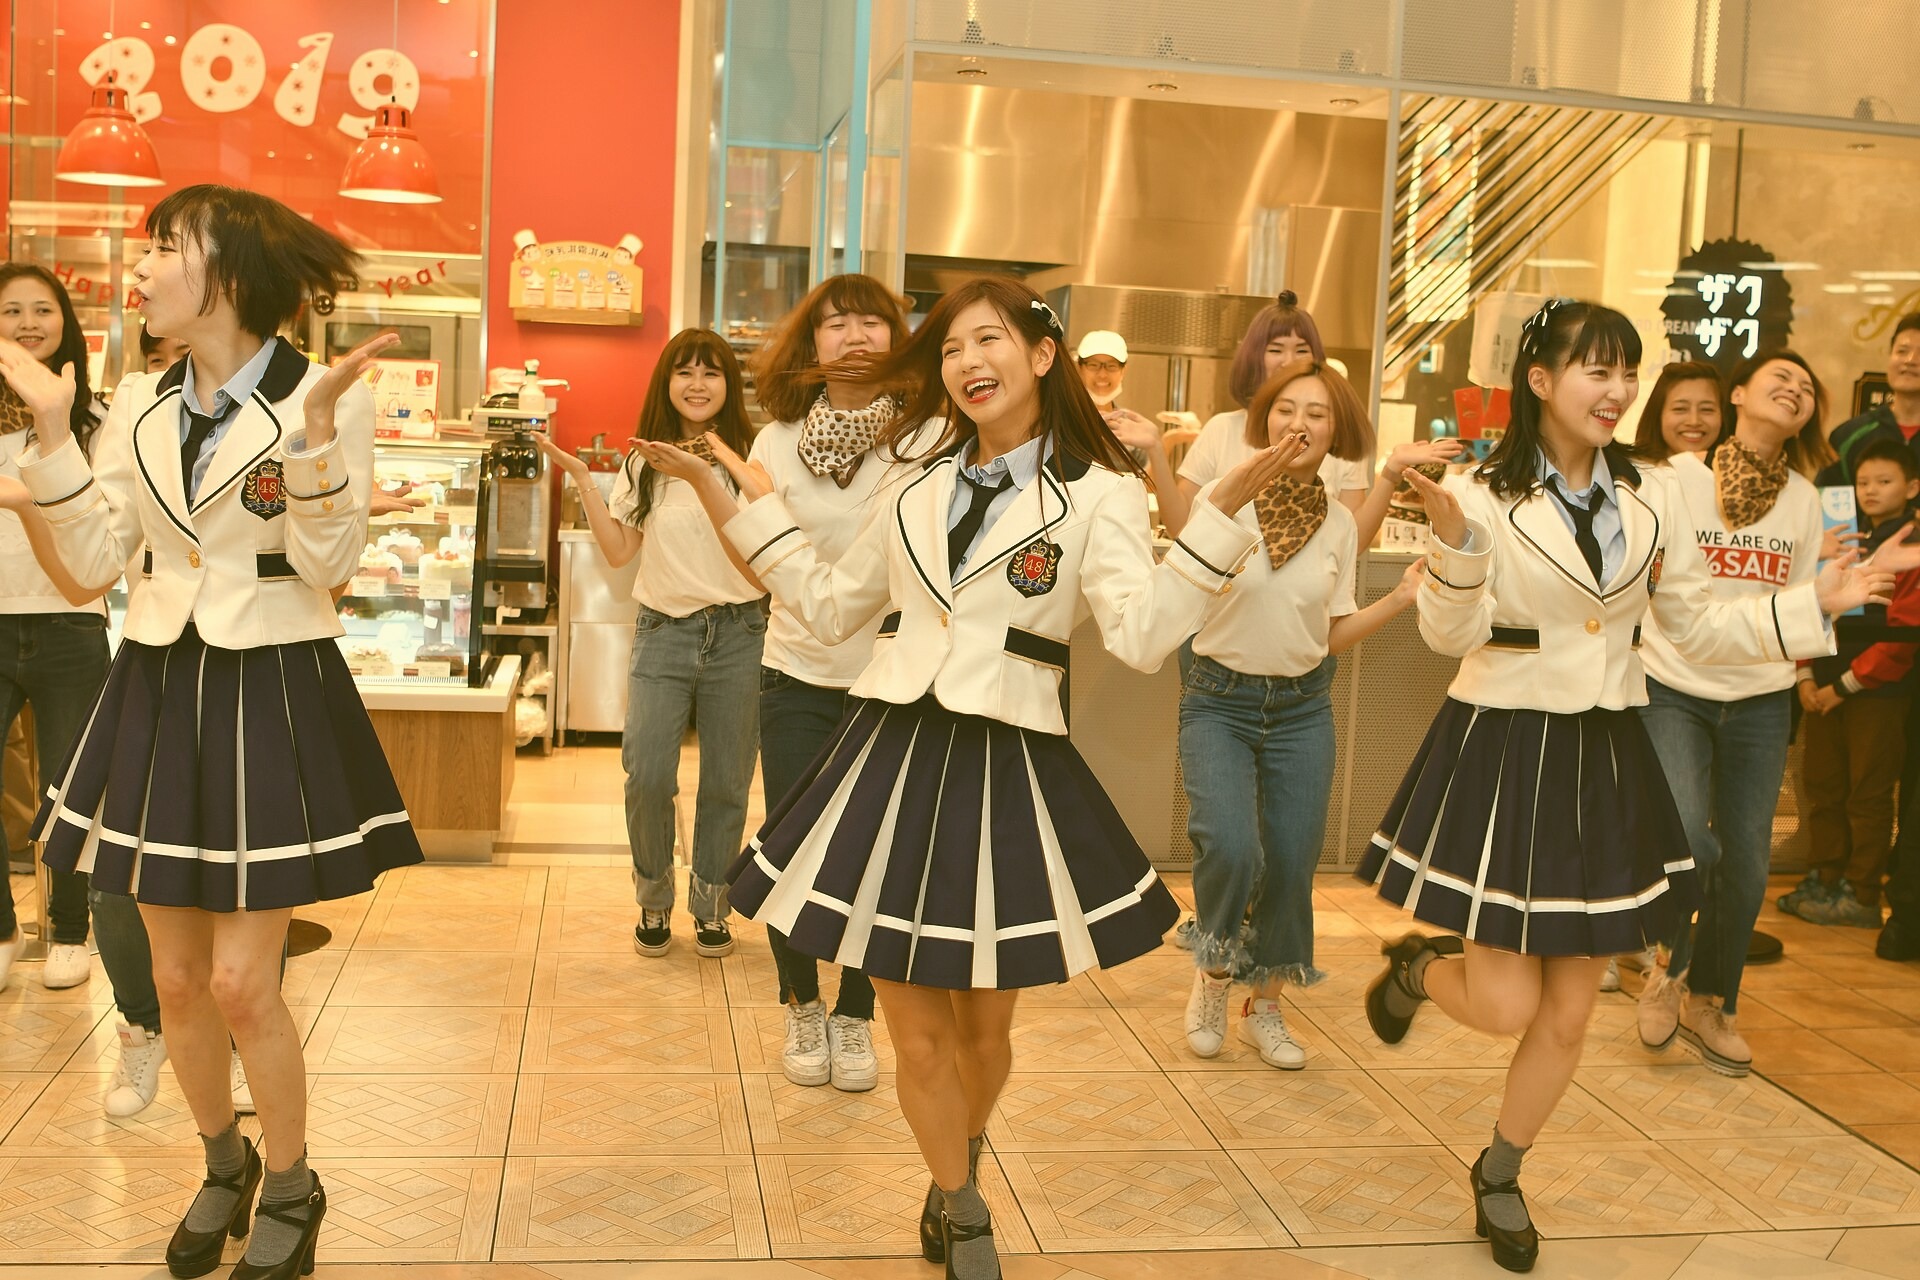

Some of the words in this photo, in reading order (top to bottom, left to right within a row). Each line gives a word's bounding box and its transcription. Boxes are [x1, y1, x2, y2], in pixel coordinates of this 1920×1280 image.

[79, 23, 421, 140] 2019
[54, 261, 143, 310] Happ
[1697, 273, 1763, 316] ザク
[1694, 317, 1760, 359] ザク
[259, 481, 277, 494] 48
[1695, 530, 1724, 546] WE
[1730, 534, 1764, 549] ARE
[1769, 538, 1793, 555] ON
[1025, 558, 1043, 573] 48
